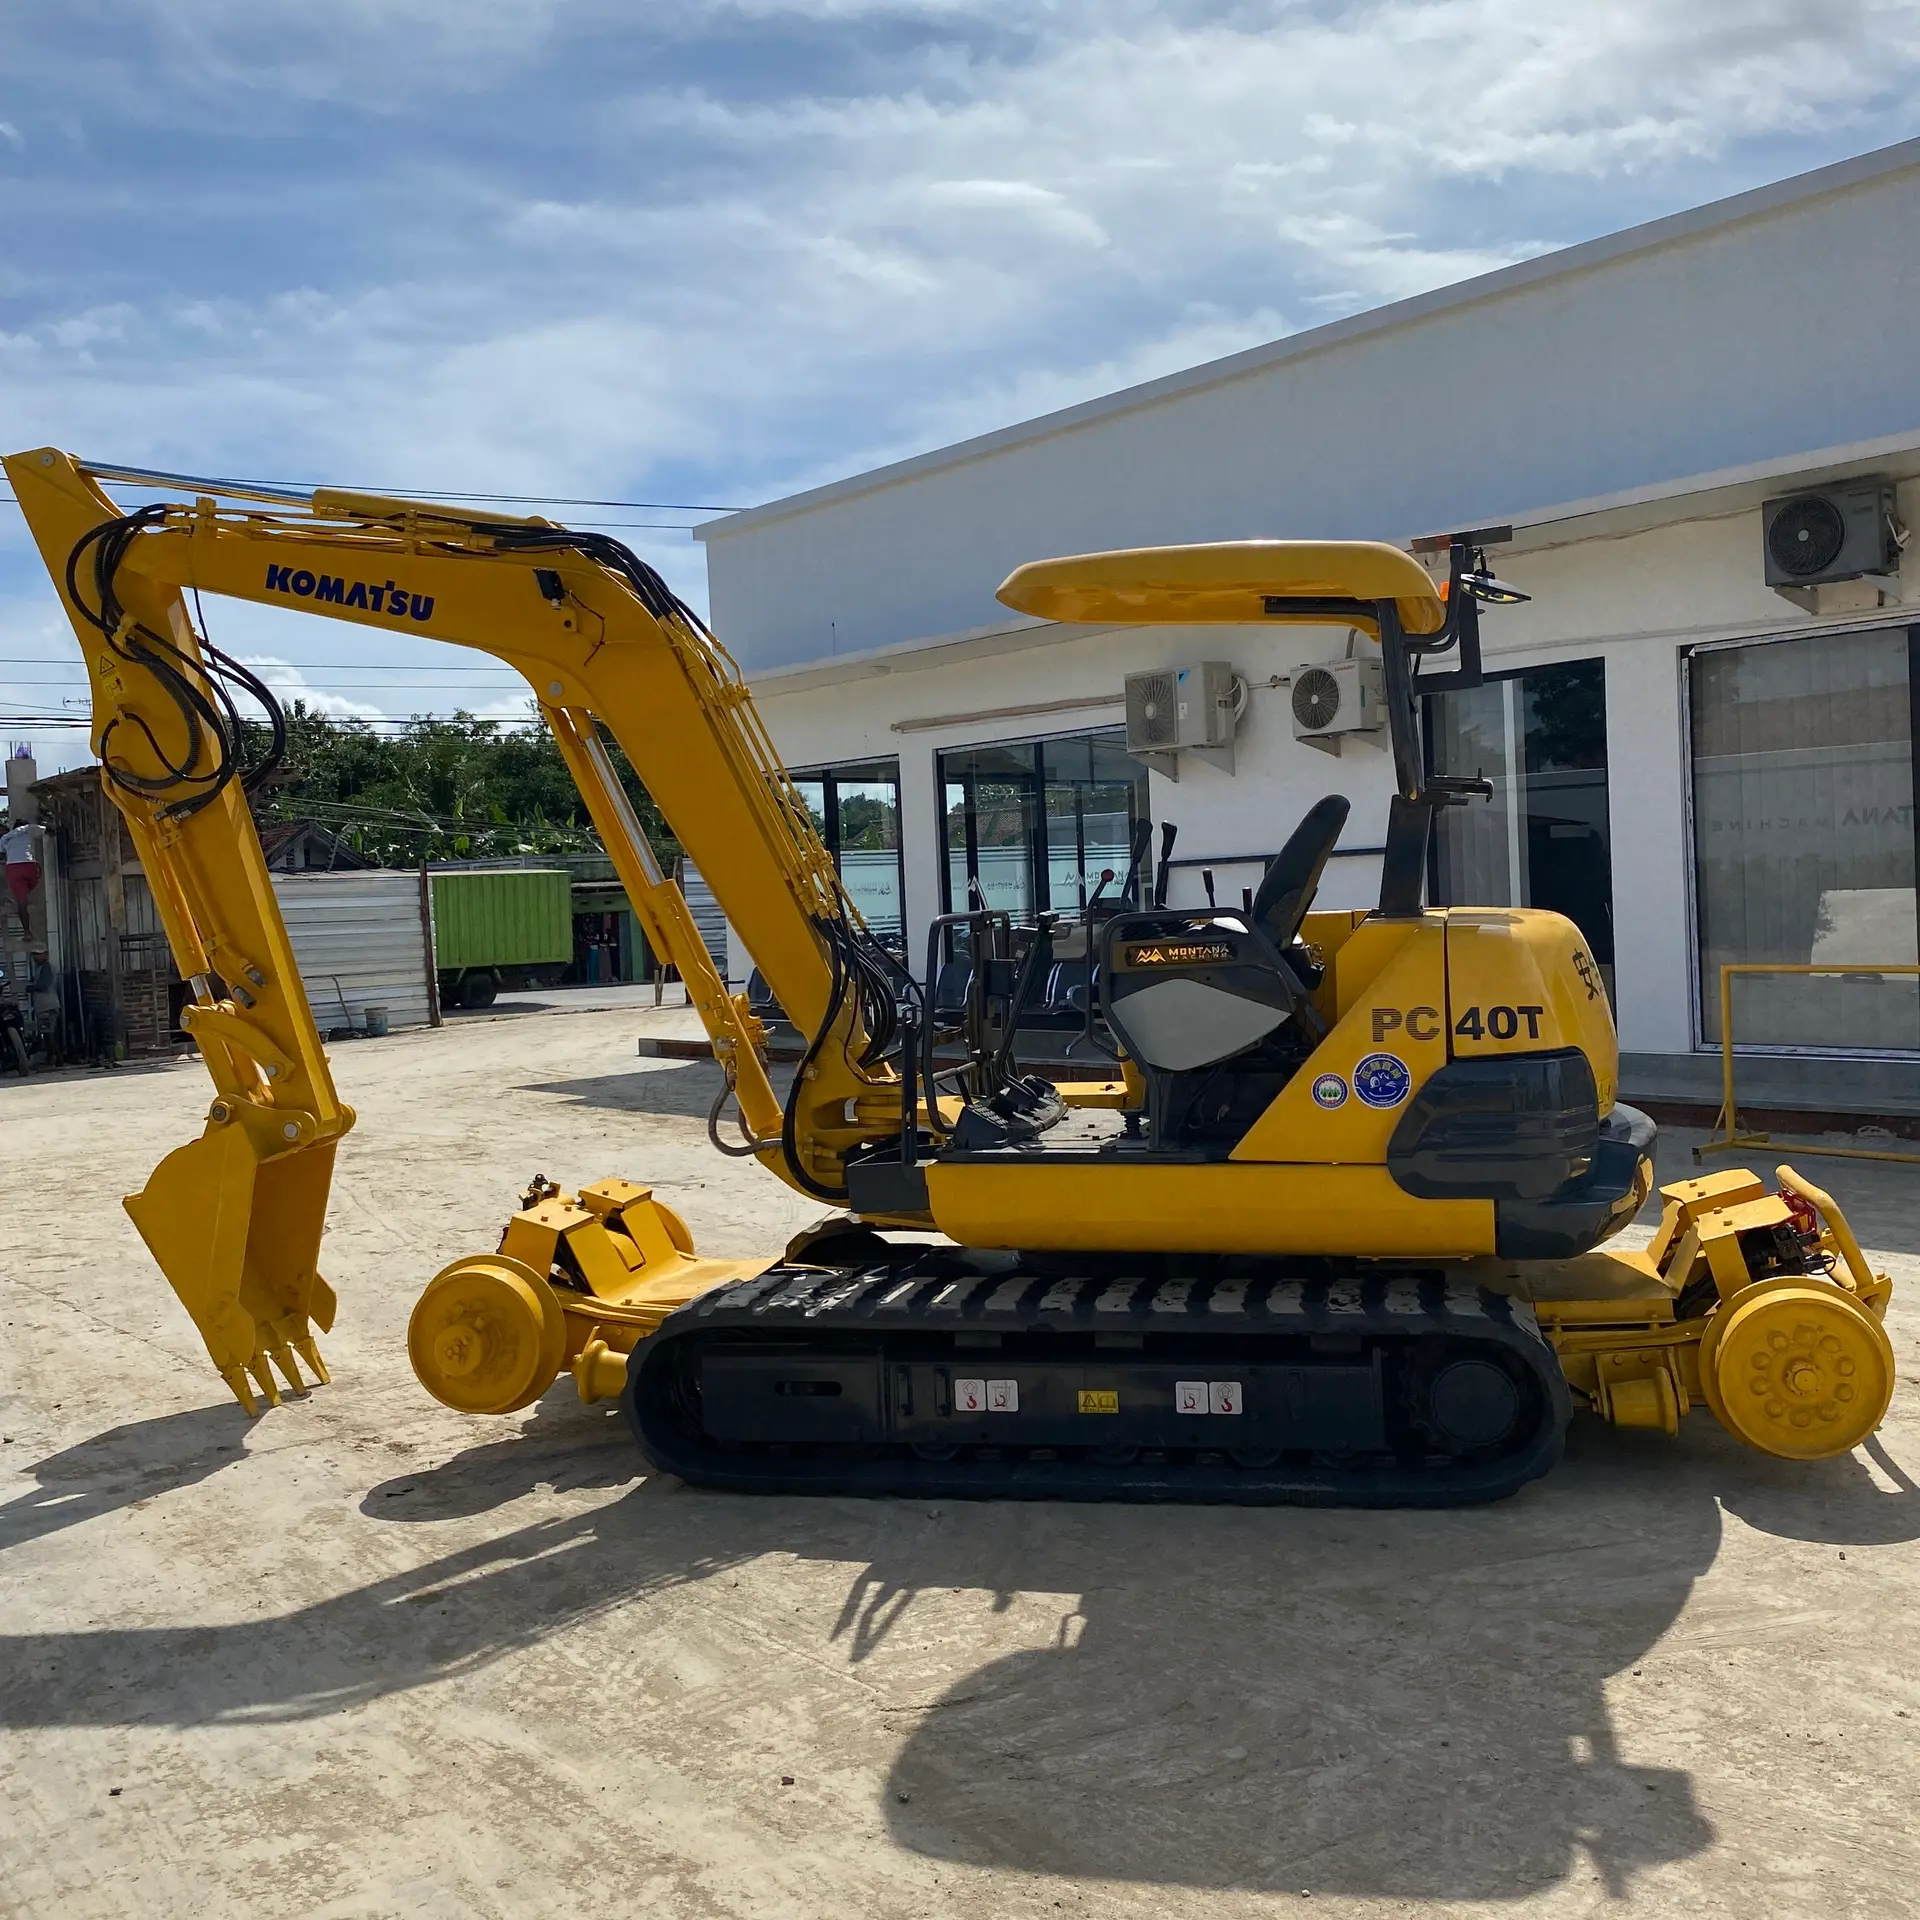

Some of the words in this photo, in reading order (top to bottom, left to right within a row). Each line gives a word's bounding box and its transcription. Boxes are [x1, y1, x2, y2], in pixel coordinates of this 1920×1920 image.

[265, 563, 435, 621] KOMATSU
[1168, 945, 1229, 956] MONTANA
[1372, 1006, 1440, 1042] PC
[1455, 1006, 1543, 1040] 40T
